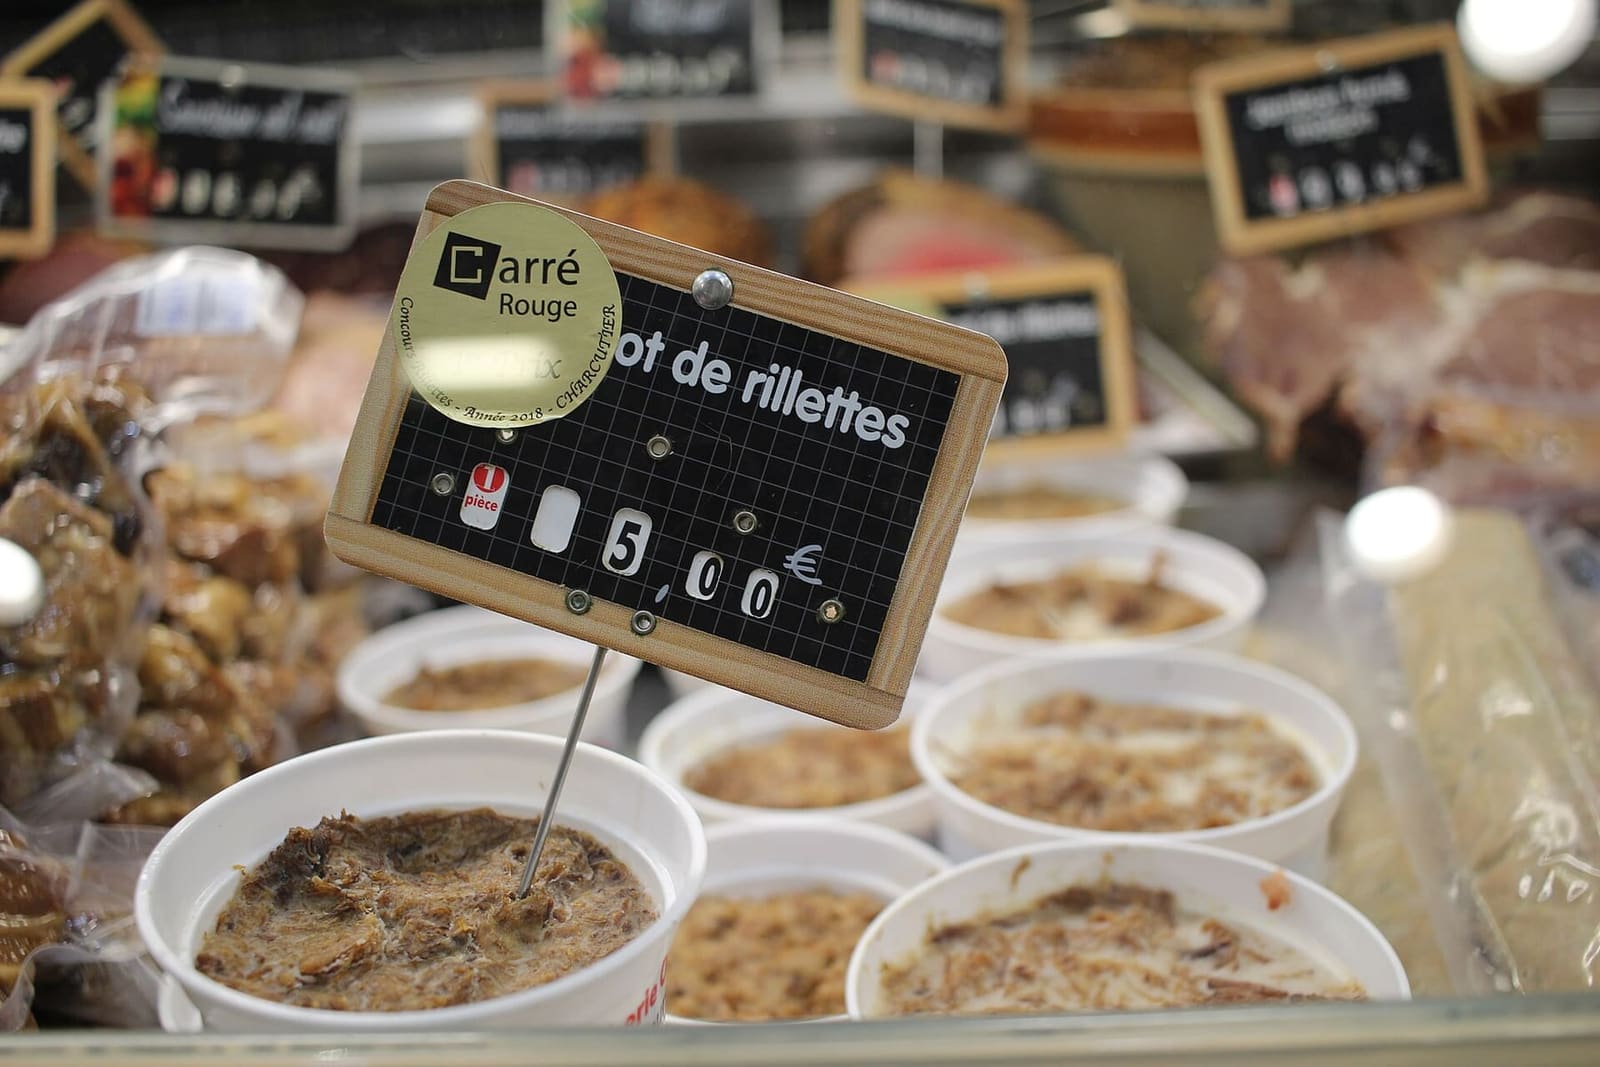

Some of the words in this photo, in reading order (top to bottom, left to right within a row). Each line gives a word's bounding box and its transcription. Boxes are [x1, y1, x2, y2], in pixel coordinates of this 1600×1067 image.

[441, 240, 581, 290] Carré
[499, 293, 577, 322] Rouge
[400, 296, 416, 359] Concours
[463, 405, 506, 422] Année
[509, 407, 544, 422] 2018
[555, 304, 616, 409] CHARCUTIER
[614, 331, 665, 373] ot
[671, 340, 732, 394] de
[741, 363, 910, 450] rillettes
[464, 493, 499, 513] pièce
[626, 984, 657, 1025] erie
